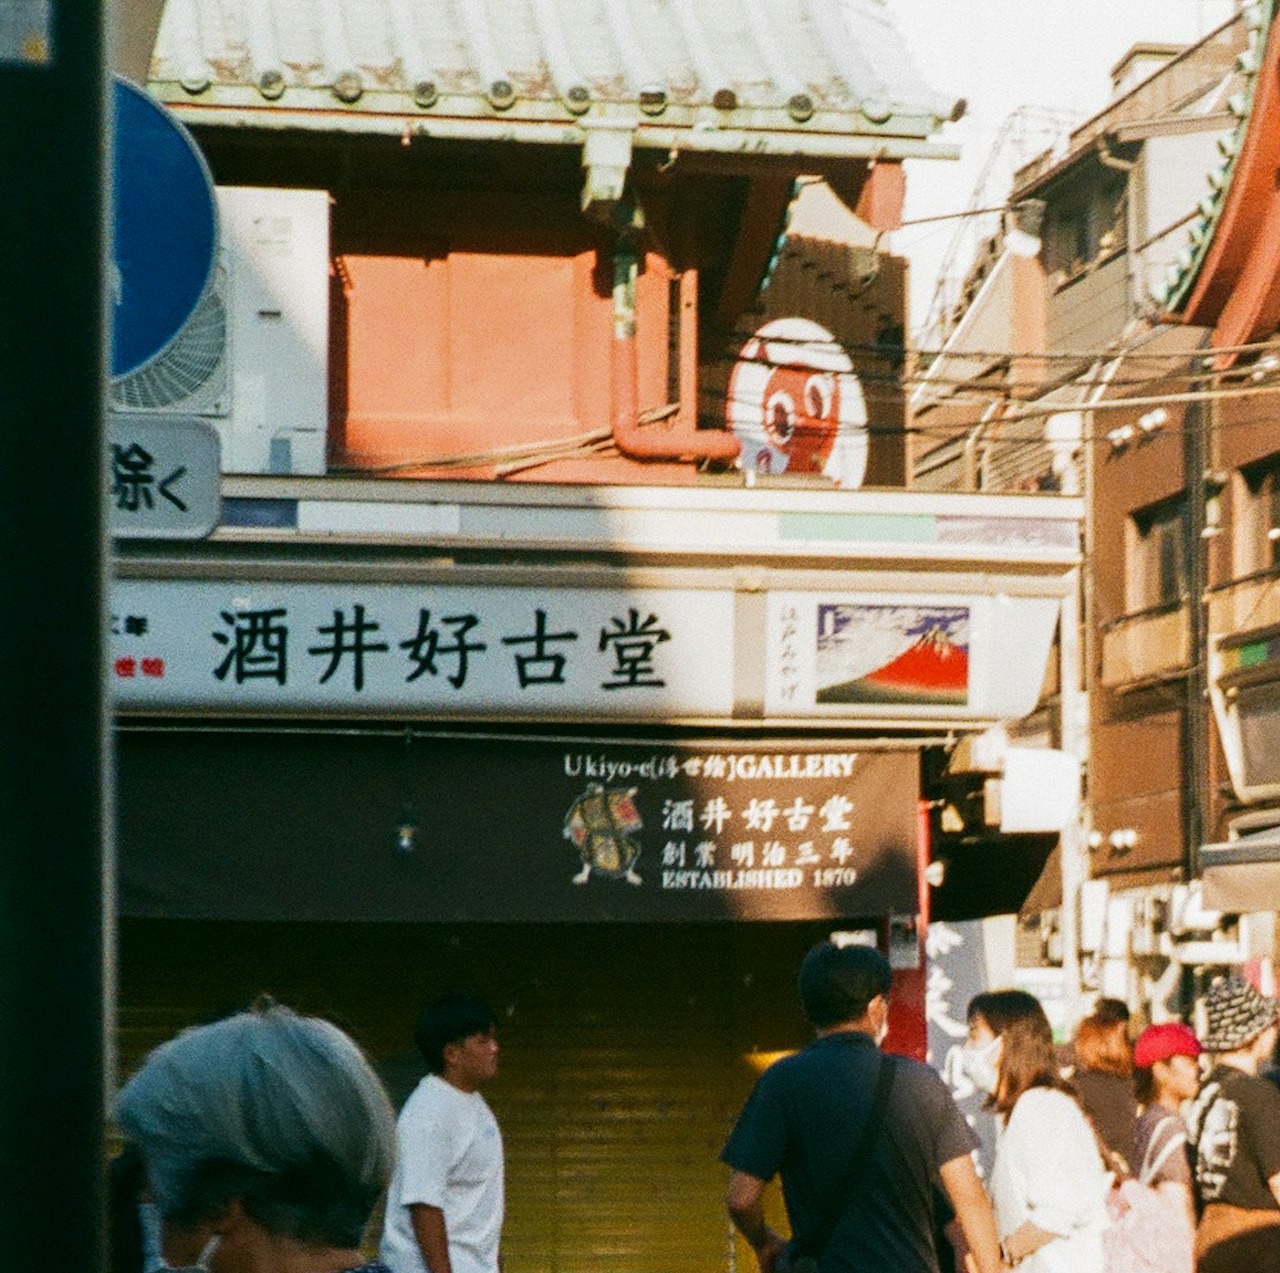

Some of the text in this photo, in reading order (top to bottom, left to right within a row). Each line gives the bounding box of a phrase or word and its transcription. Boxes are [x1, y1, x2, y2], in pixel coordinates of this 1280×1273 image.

[211, 603, 673, 691] 酒井好古堂
[662, 868, 858, 889] ESTABLISHED 1870
